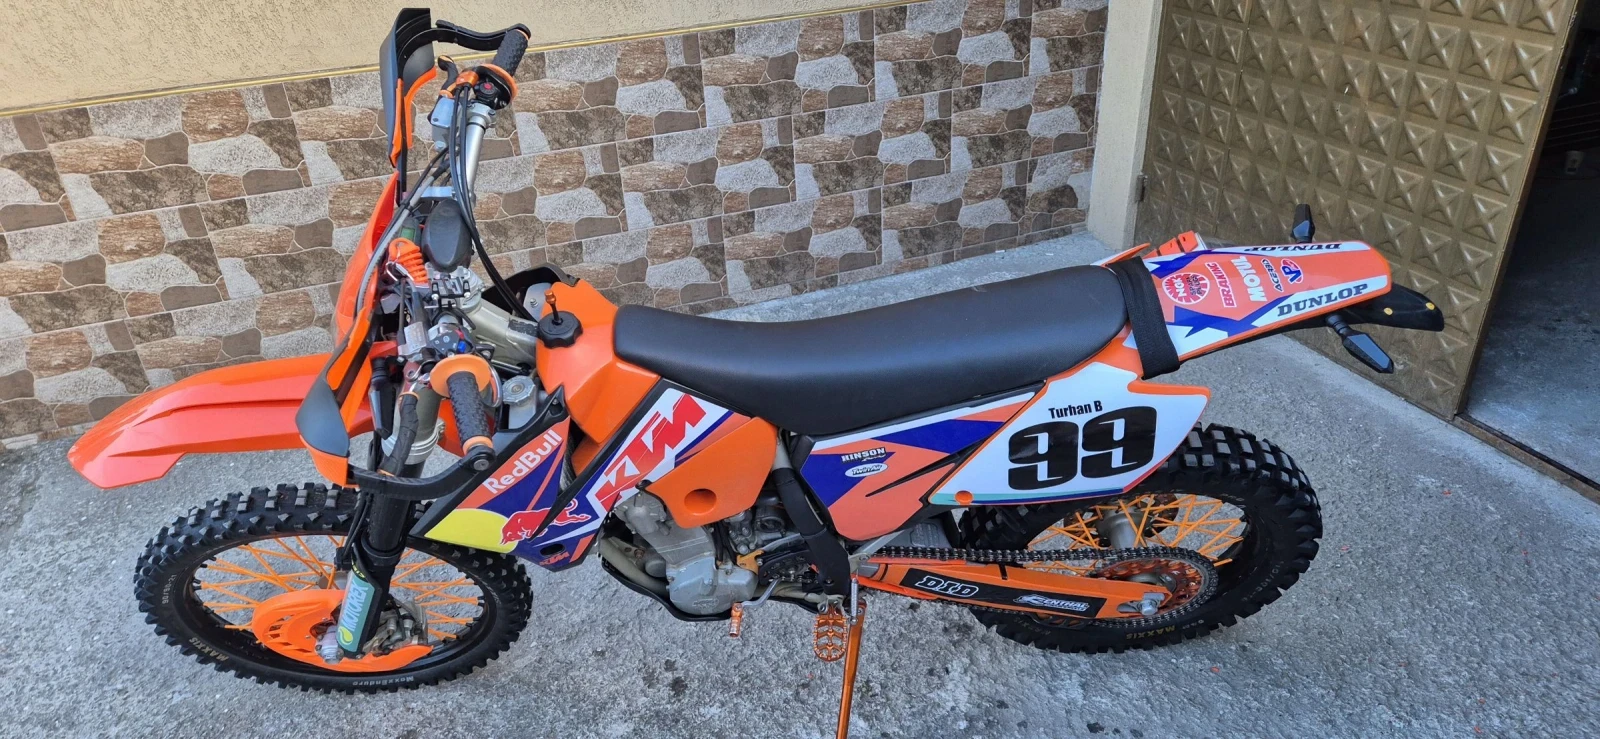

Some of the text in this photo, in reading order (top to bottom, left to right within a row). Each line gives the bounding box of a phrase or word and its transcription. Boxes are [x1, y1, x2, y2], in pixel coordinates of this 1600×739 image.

[1206, 262, 1233, 307] BRAKING
[1231, 255, 1268, 302] MOTUL
[1282, 265, 1302, 283] VP
[1173, 277, 1187, 297] NGK
[1277, 283, 1368, 317] DUNLOP
[1048, 400, 1103, 420] Turhan B
[595, 392, 706, 513] KTM
[841, 447, 886, 462] HINSON
[1008, 406, 1158, 491] 99
[915, 575, 979, 597] DID
[341, 580, 369, 631] MOTOREX
[1126, 624, 1175, 640] MAXXIS
[188, 637, 229, 662] MAXXIS
